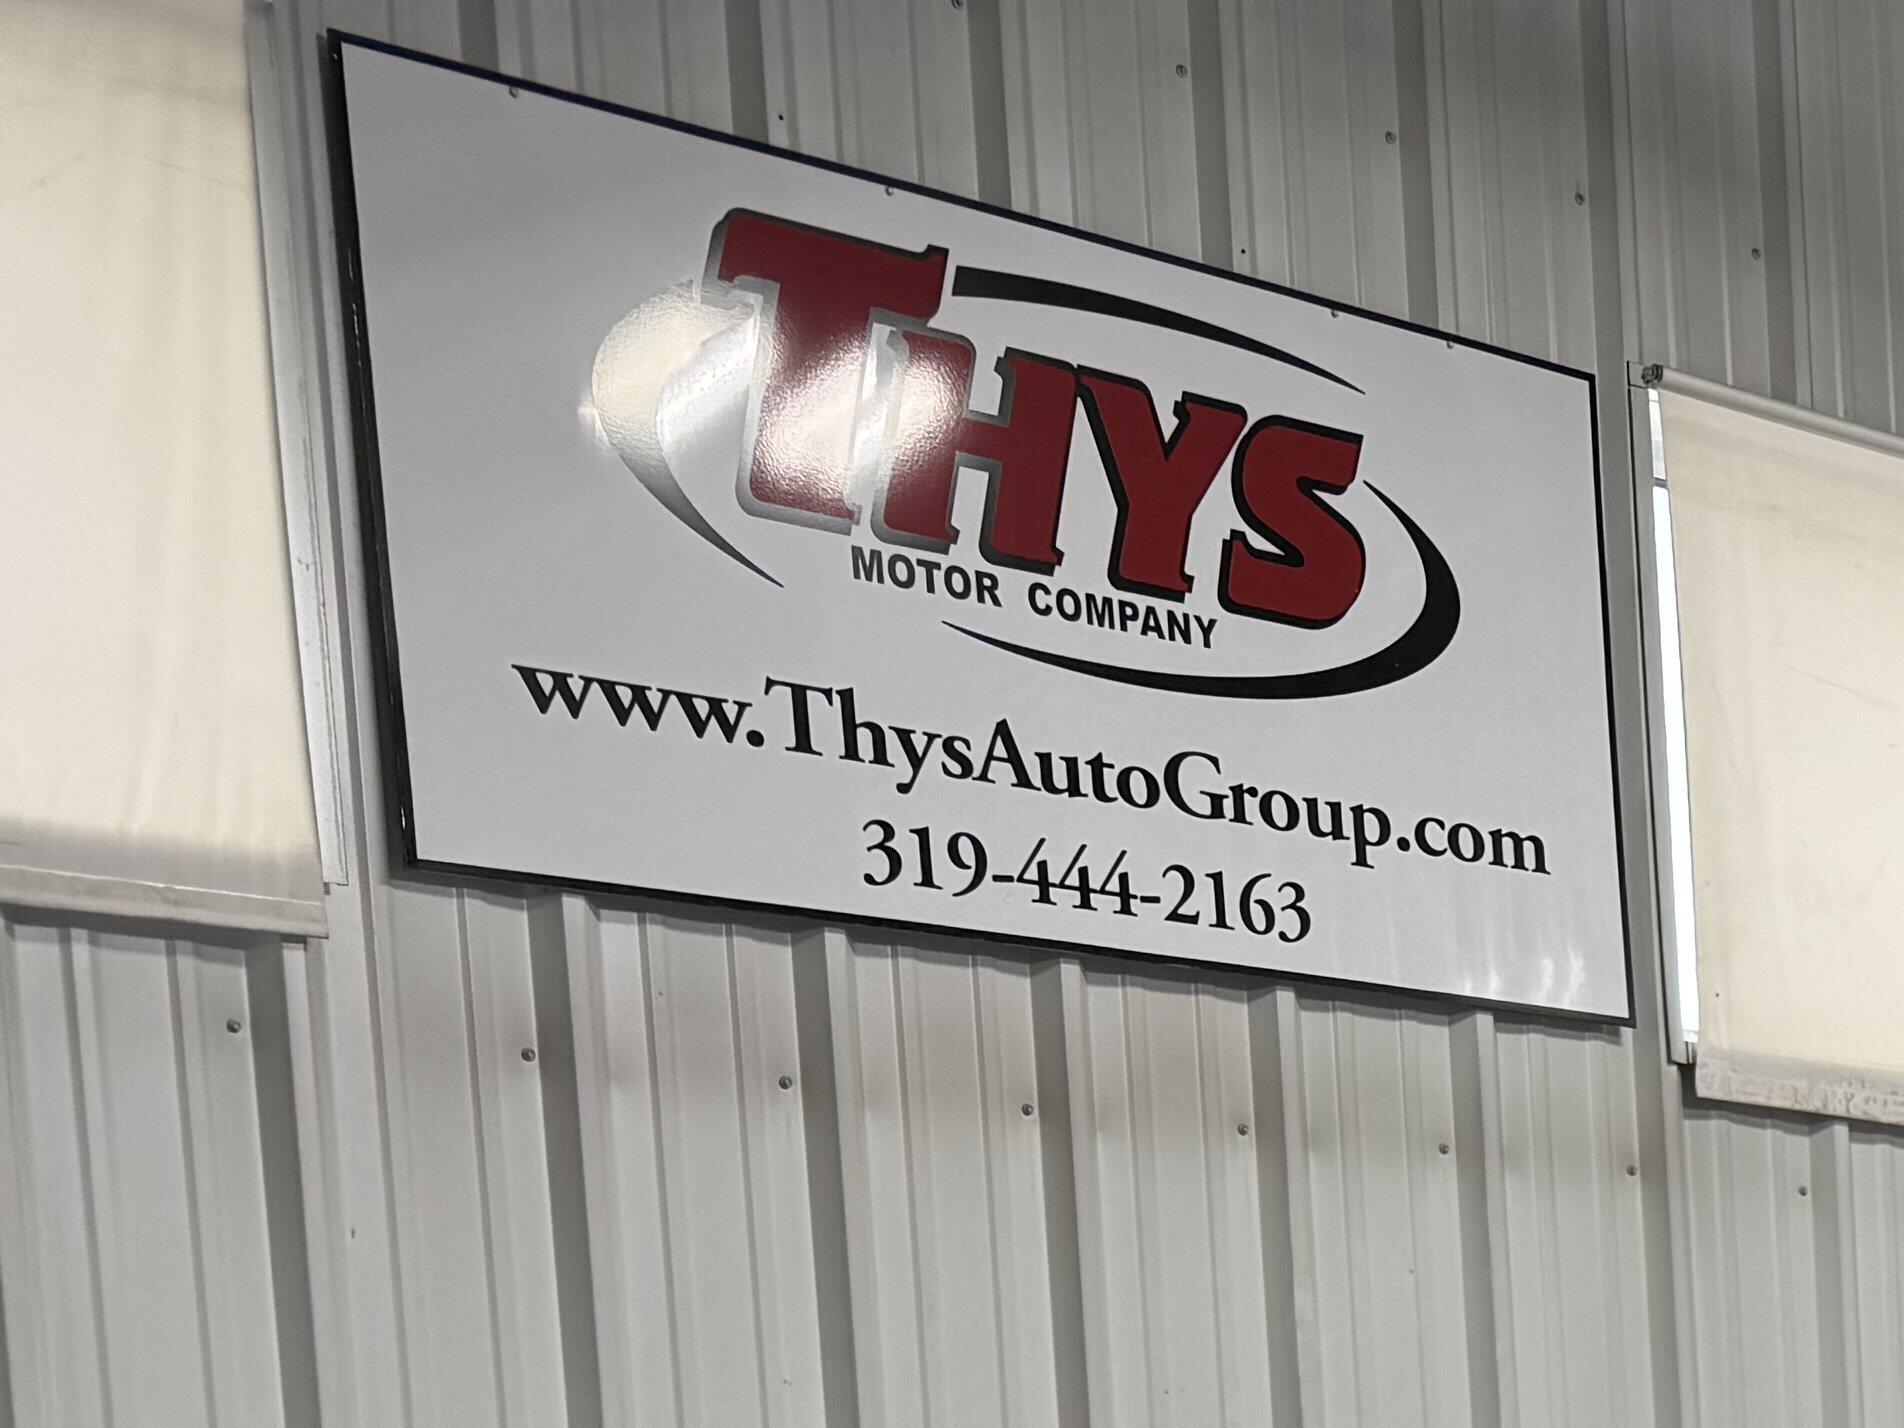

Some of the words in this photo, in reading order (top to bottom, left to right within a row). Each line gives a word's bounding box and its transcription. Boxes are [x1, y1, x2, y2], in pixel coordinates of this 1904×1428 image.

[702, 207, 1366, 630] THYS
[852, 546, 1002, 608] MOTOR
[1028, 583, 1217, 650] COMPANY
[512, 664, 1551, 876] www.ThysAutoGroup.com
[862, 819, 1313, 943] 319-444-2163
